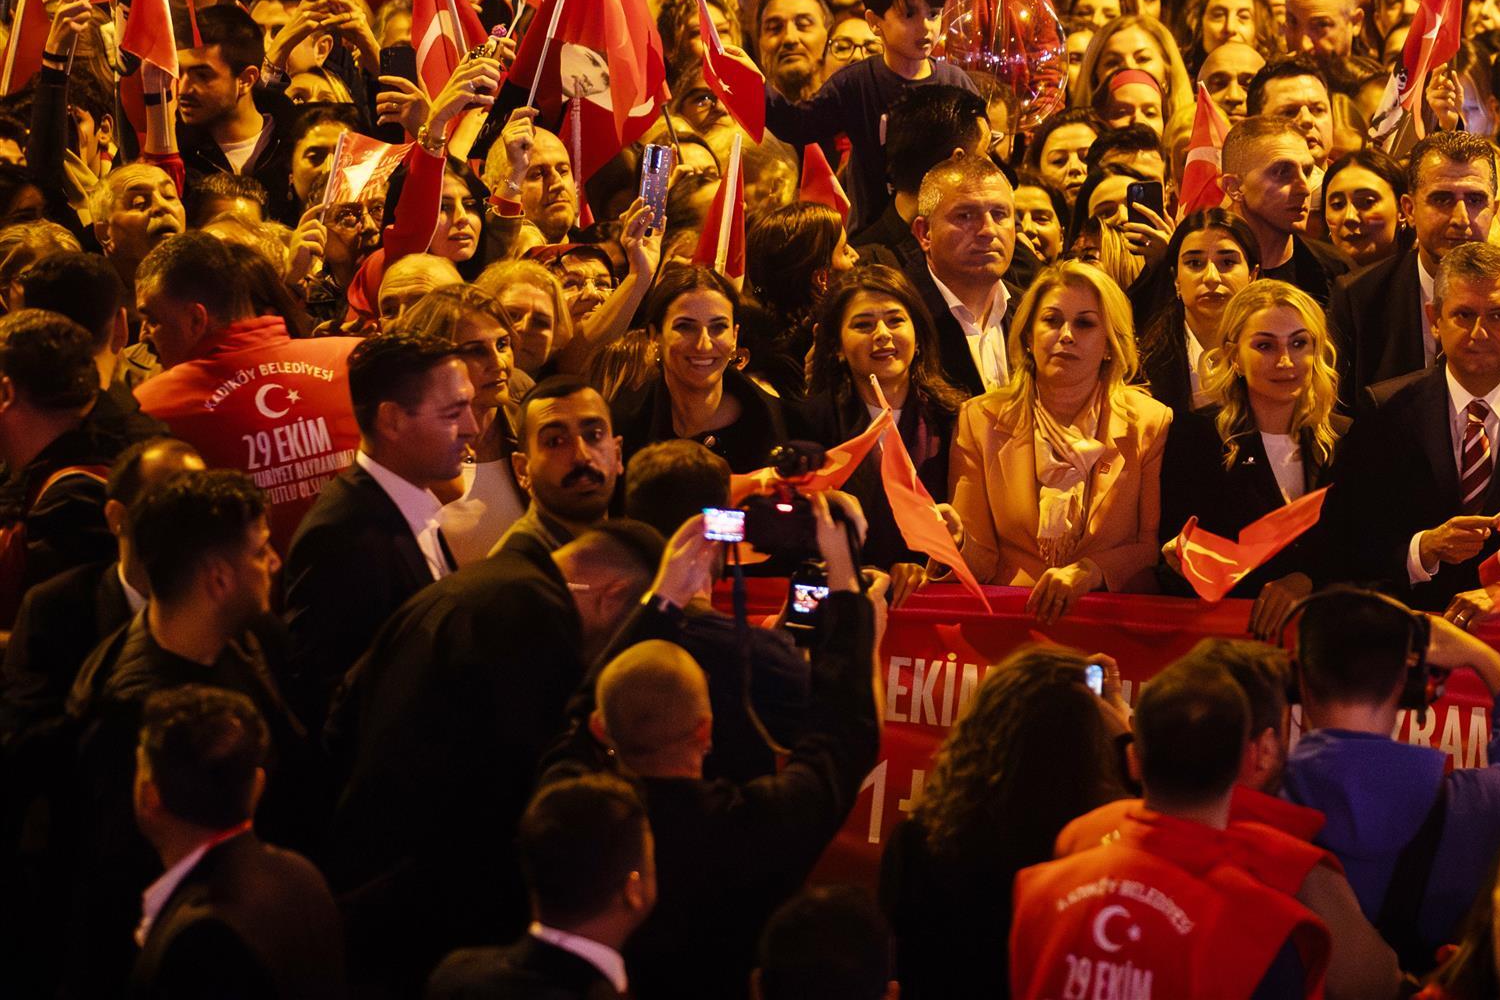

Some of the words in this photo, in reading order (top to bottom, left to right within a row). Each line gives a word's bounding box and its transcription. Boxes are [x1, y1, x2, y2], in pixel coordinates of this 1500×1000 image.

[204, 368, 256, 412] KADIKÖY
[258, 361, 334, 383] BELEDİYESİ
[242, 430, 272, 470] 29
[273, 416, 333, 463] EKİM
[1063, 953, 1093, 999] 29
[1092, 959, 1153, 1000] EKİM
